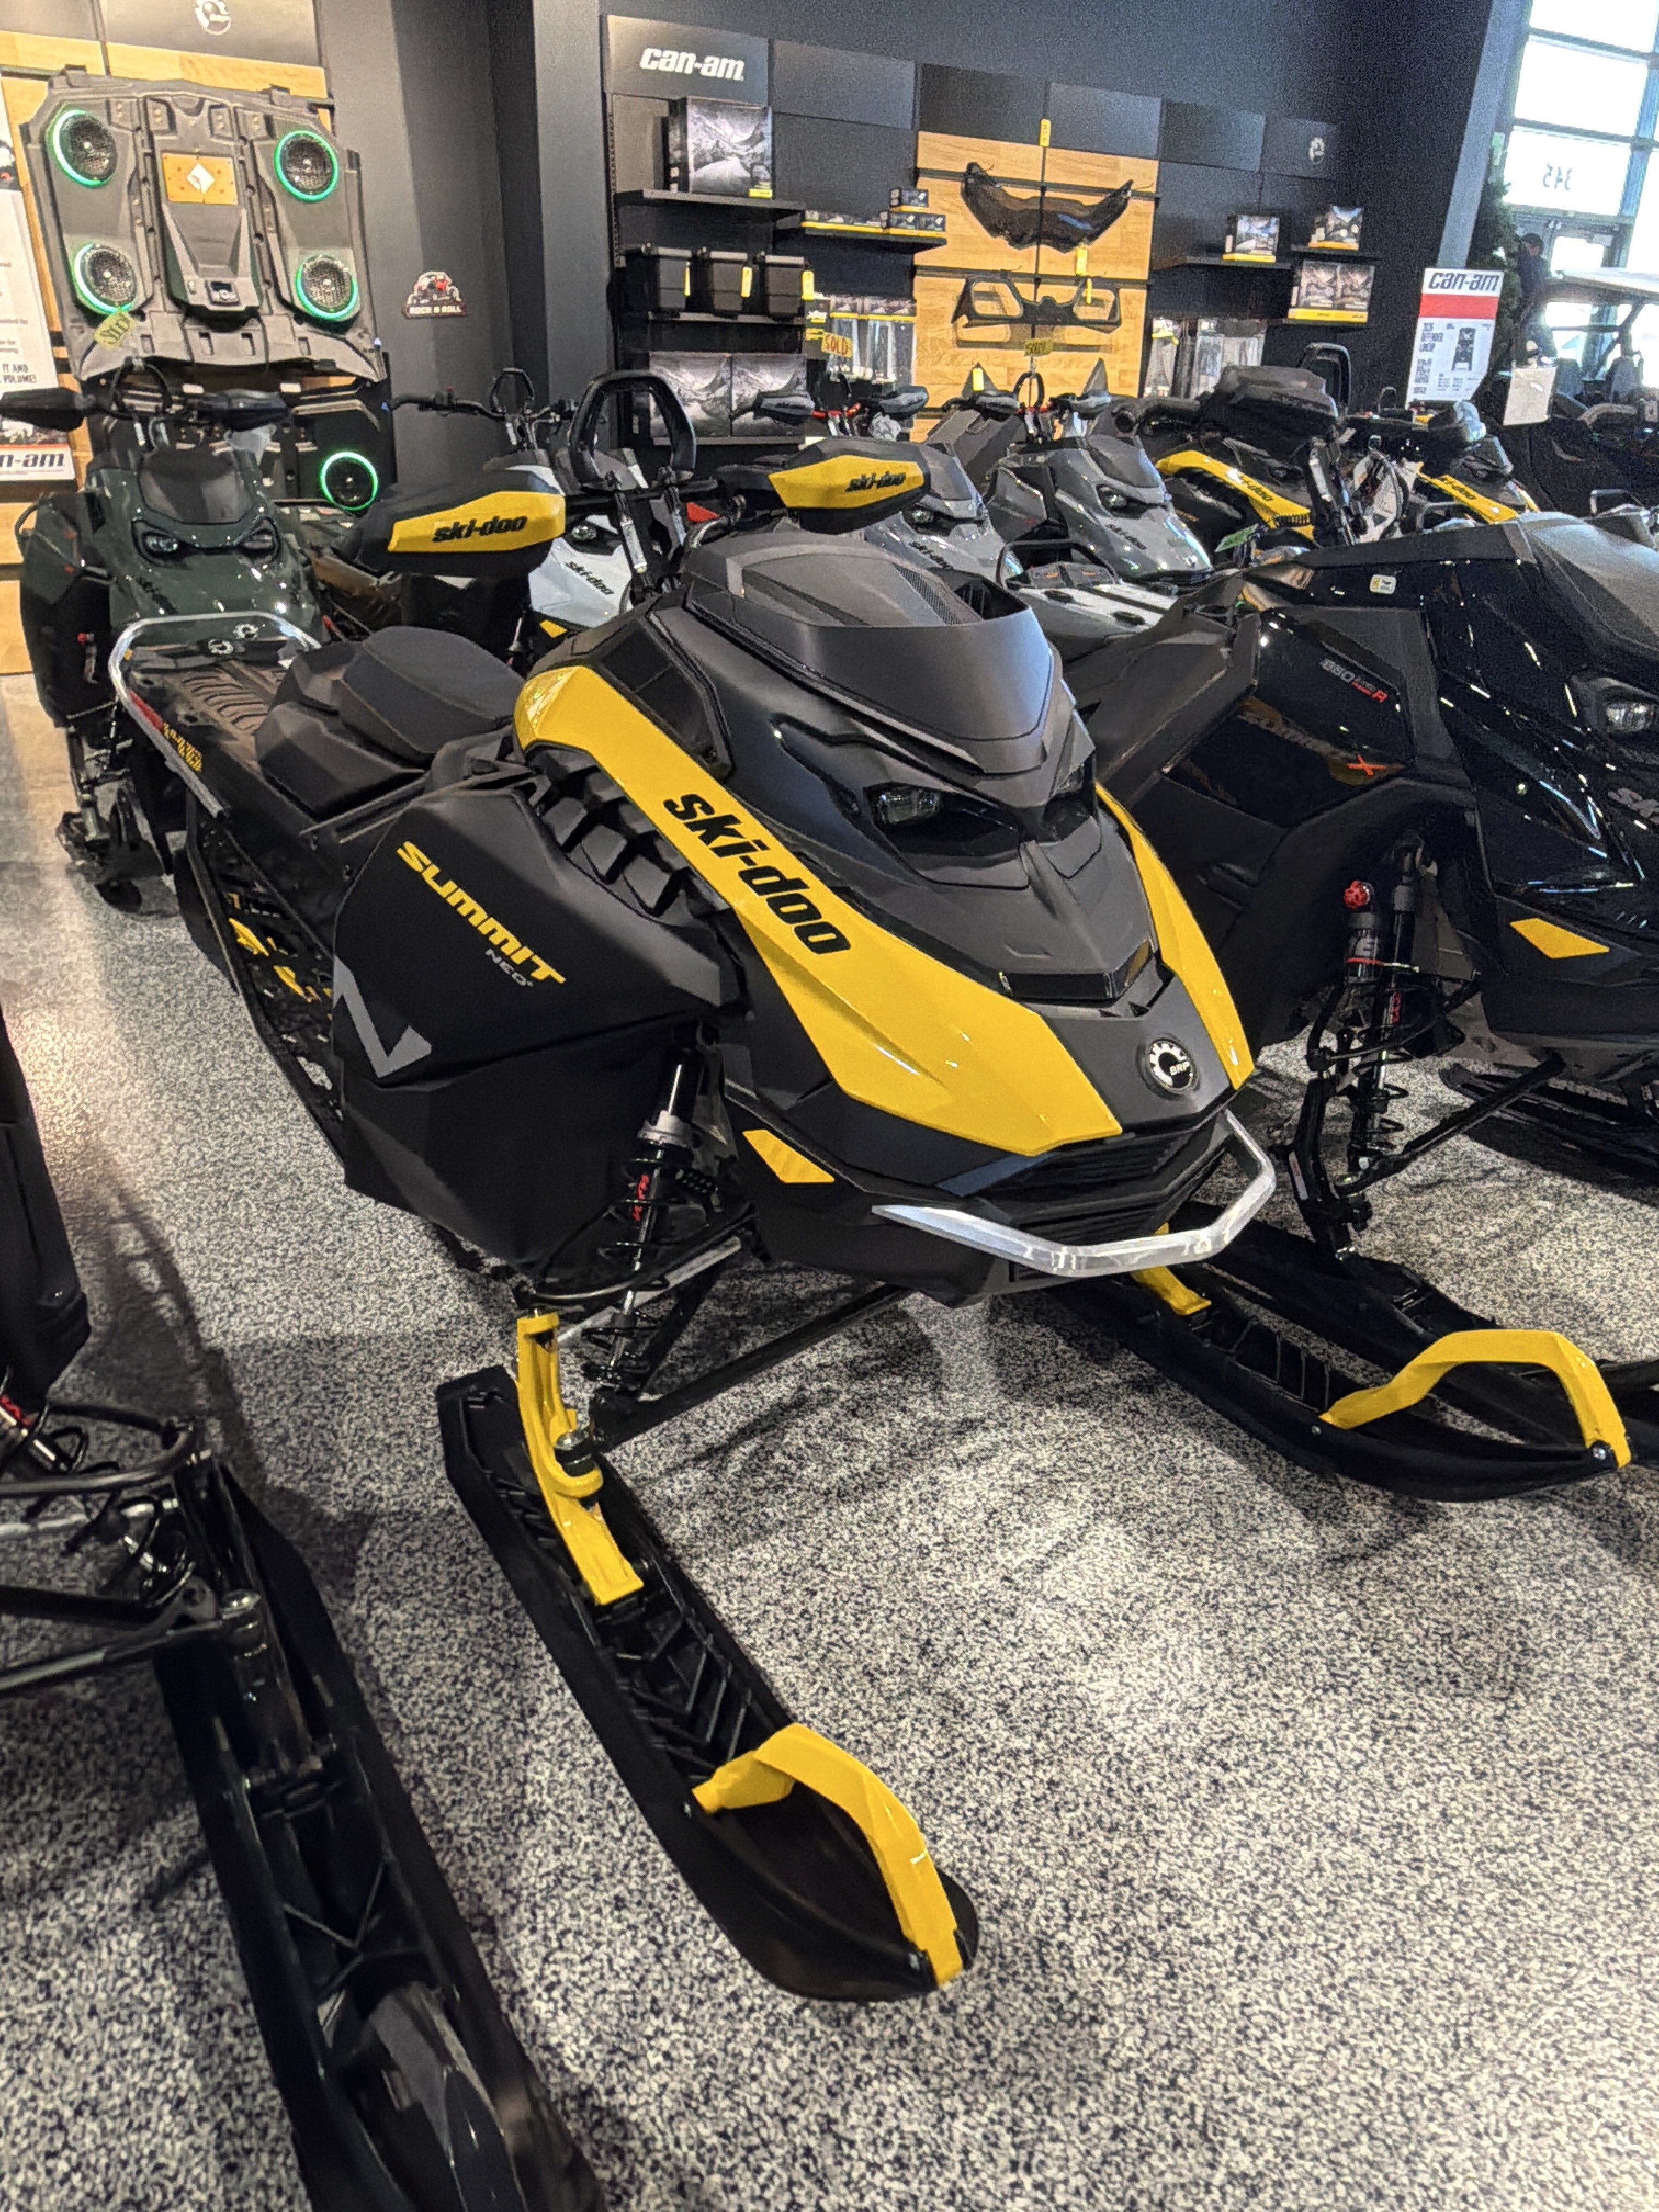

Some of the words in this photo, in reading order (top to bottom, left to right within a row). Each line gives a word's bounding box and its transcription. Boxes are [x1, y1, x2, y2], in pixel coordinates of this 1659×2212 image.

[640, 47, 745, 81] can-am
[1428, 272, 1500, 291] can-am
[825, 334, 848, 355] SOLD
[845, 471, 906, 493] ski-doo
[432, 516, 528, 543] ski-doo
[1105, 523, 1148, 550] ski-doo
[565, 561, 615, 595] ski-doo
[663, 793, 851, 955] ski-doo
[1169, 1060, 1190, 1075] BRP
